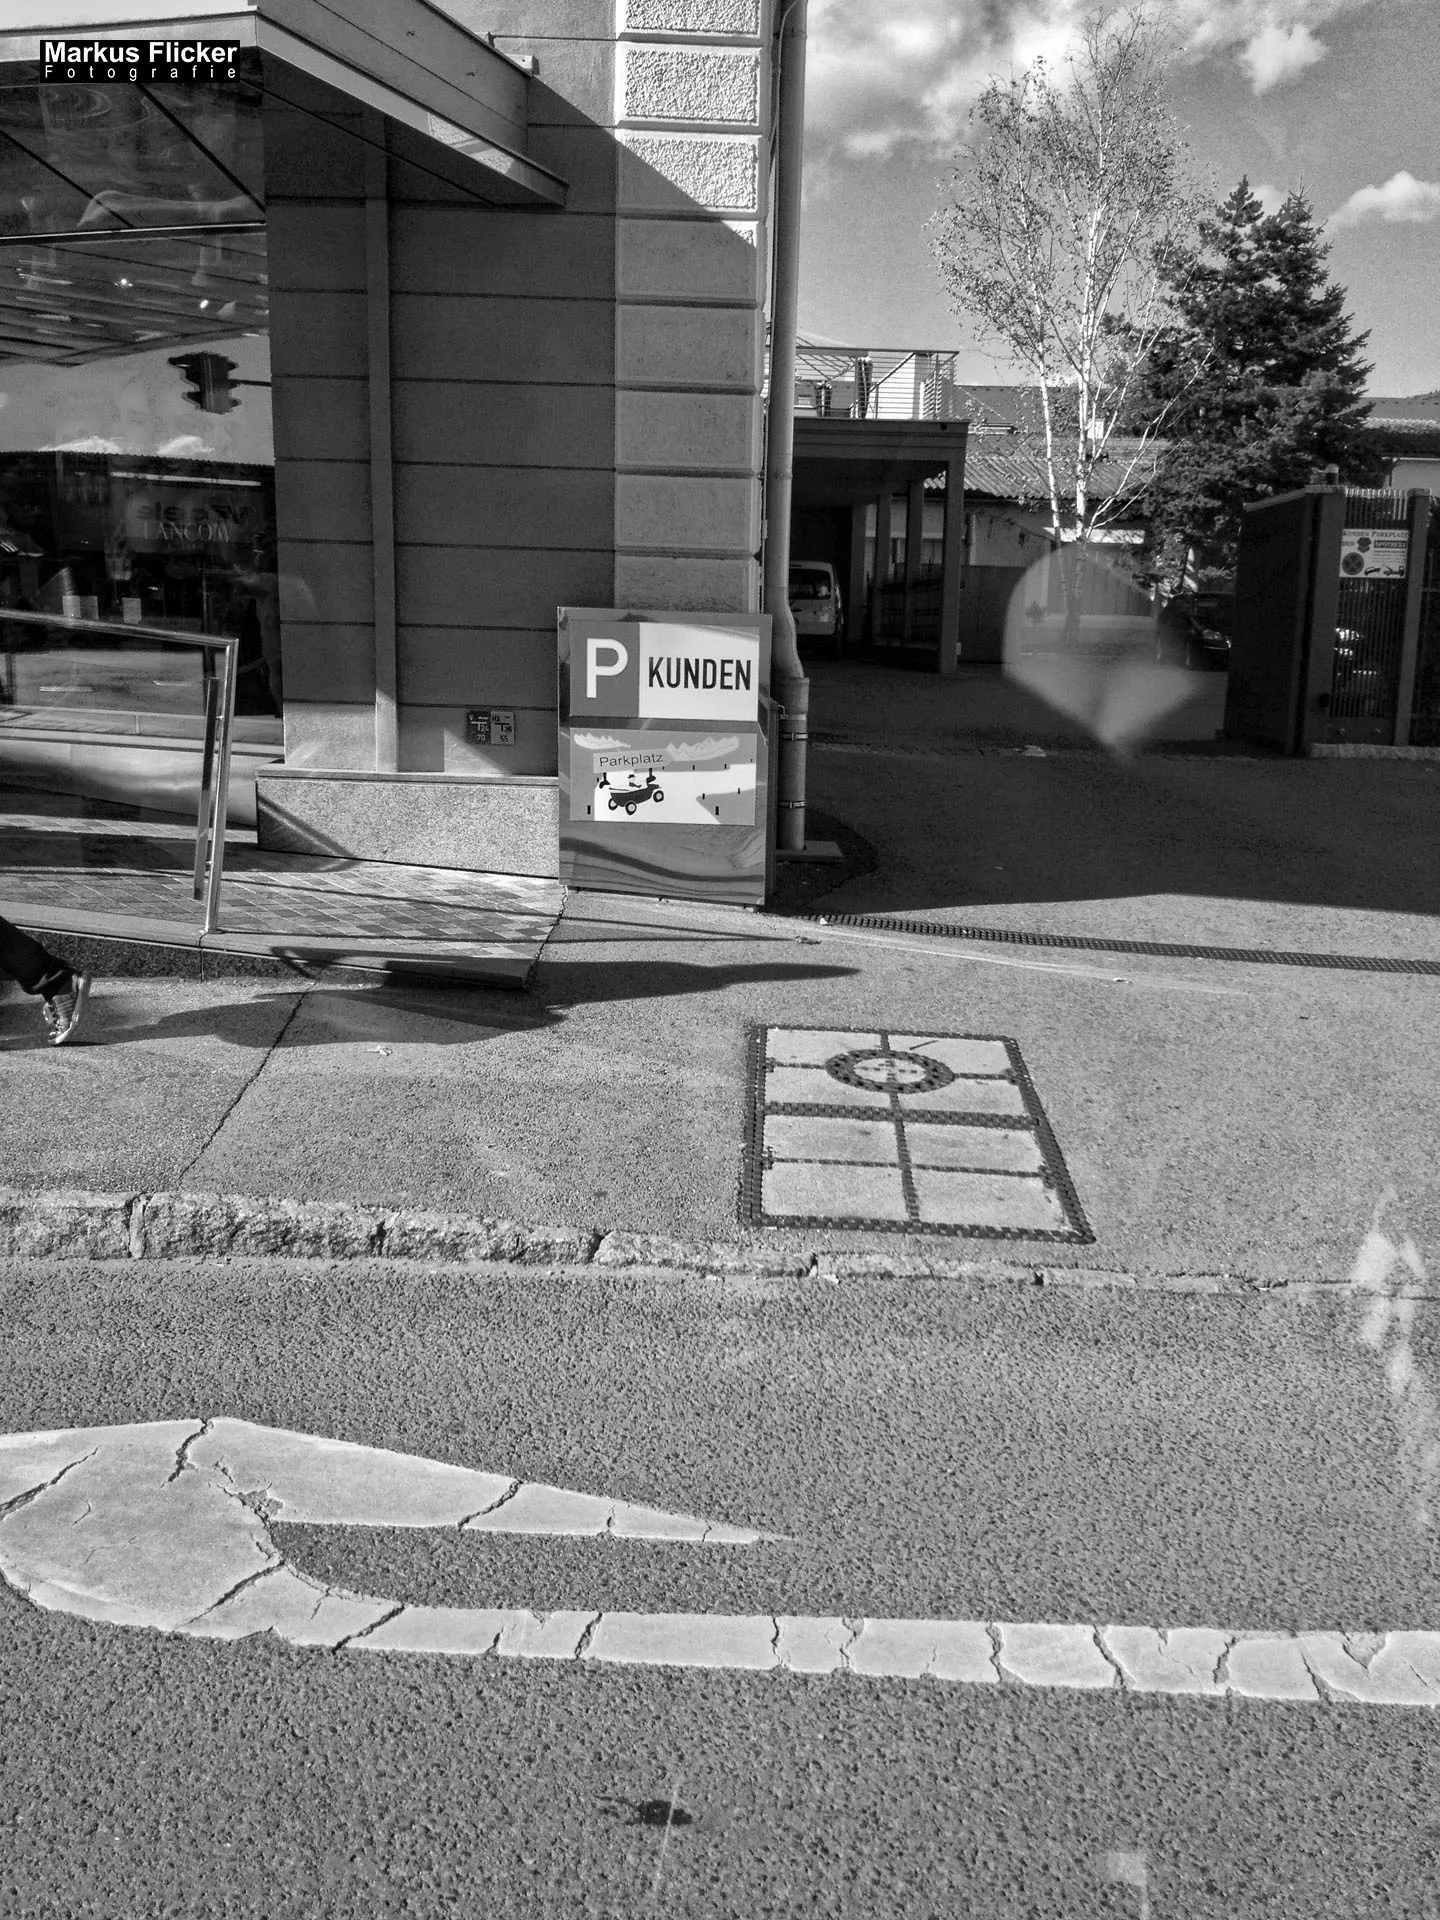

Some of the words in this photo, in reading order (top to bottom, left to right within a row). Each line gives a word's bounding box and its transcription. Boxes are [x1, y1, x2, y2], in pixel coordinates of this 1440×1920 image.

[586, 637, 628, 699] P
[648, 656, 752, 691] KUNDEN
[599, 753, 664, 768] Parkplatz
